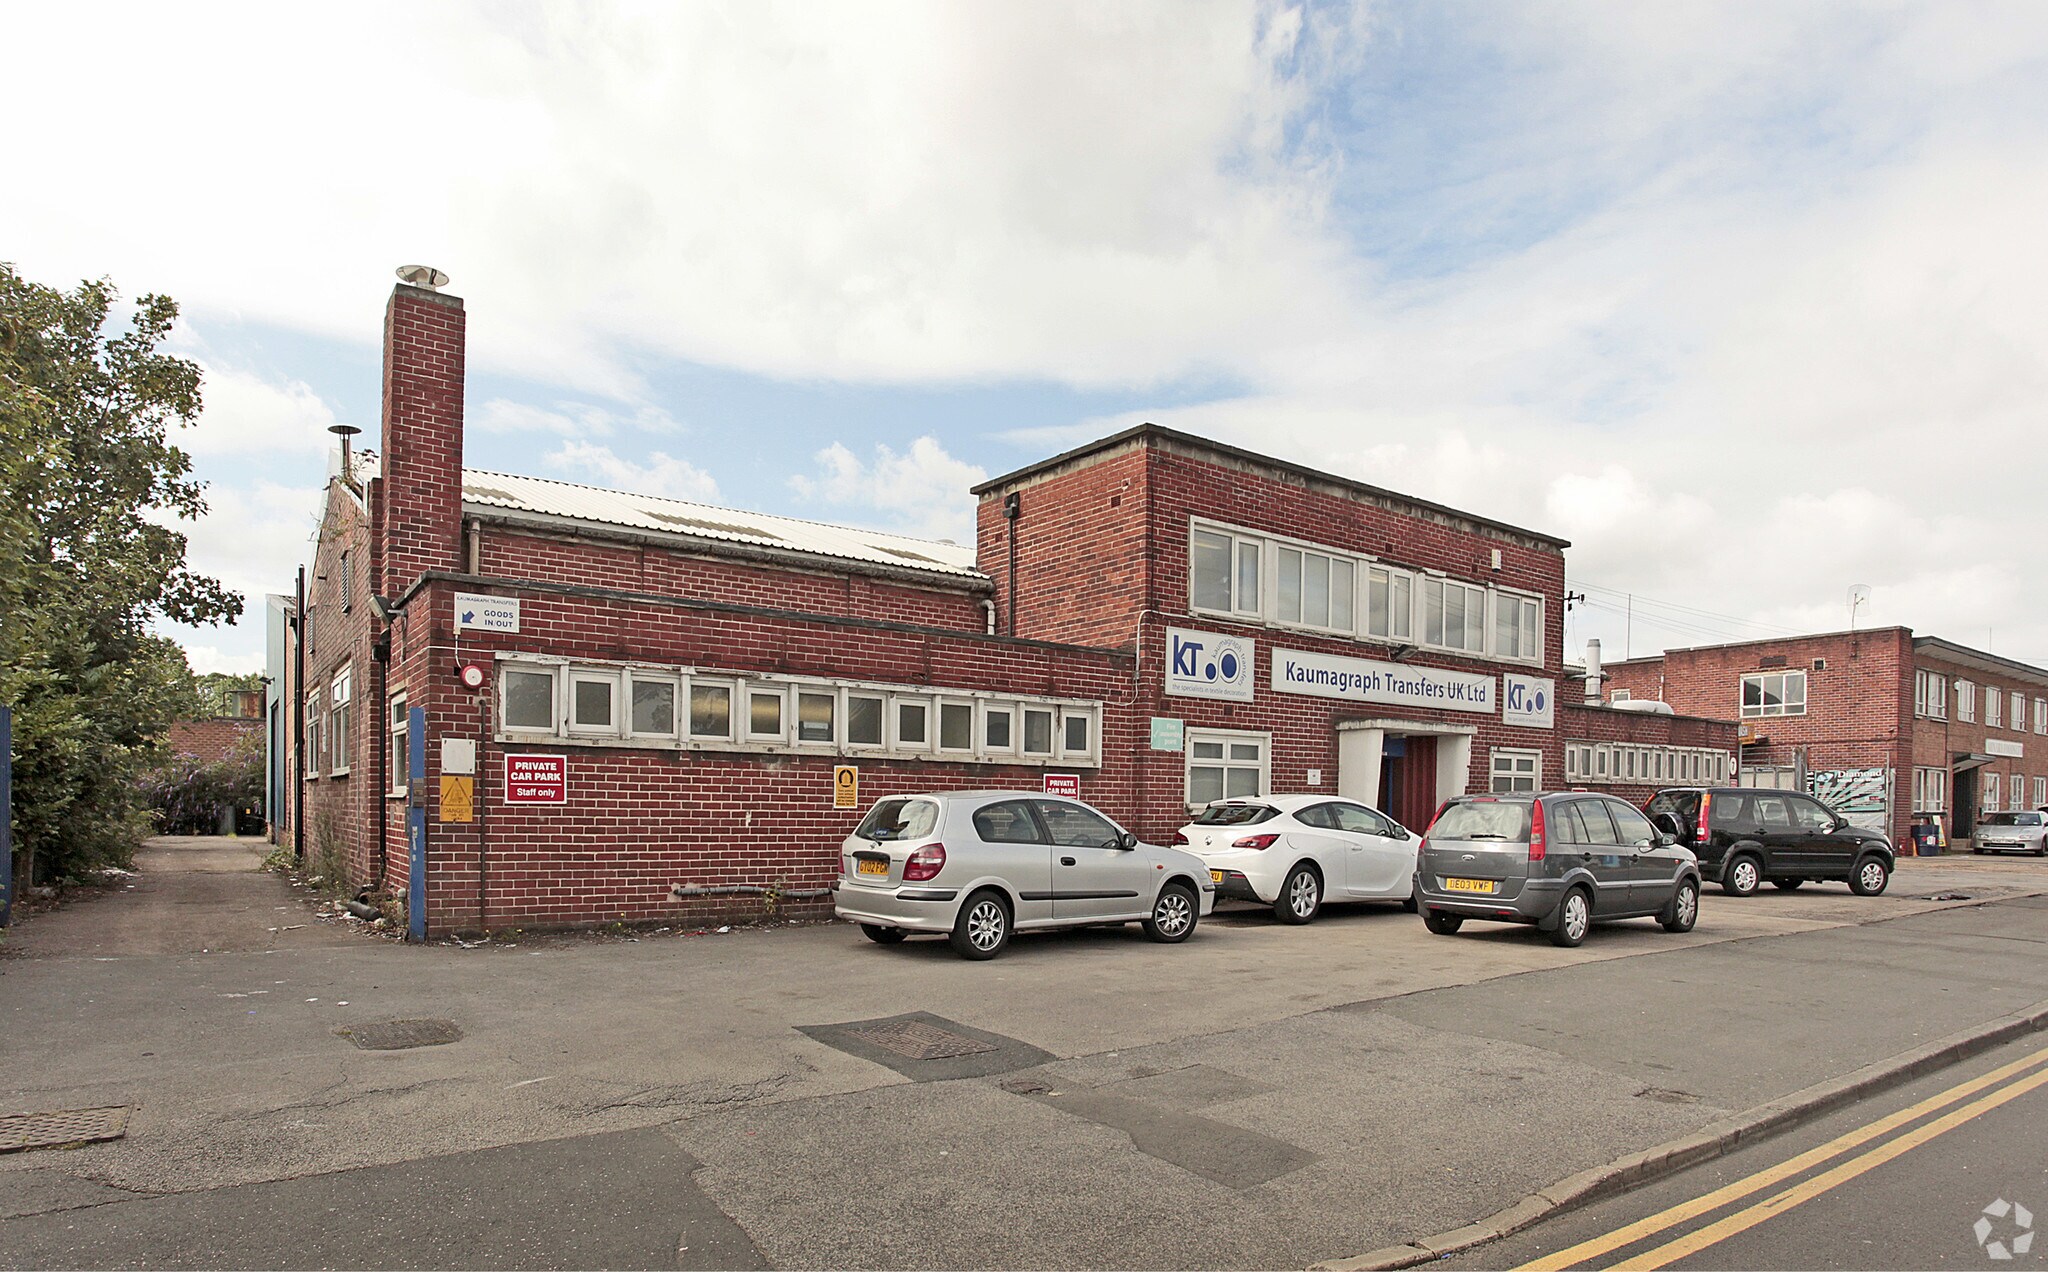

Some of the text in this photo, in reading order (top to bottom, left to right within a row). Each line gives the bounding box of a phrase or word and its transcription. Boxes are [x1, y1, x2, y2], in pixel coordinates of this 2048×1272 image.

[484, 609, 514, 619] GOODS
[484, 619, 513, 628] IN/OUT
[1173, 634, 1204, 677] KT
[1211, 638, 1247, 686] kaumagraph transfers
[1286, 660, 1486, 703] Kaumagraph Transfers UK Ltd
[1181, 685, 1204, 693] specialists
[1224, 689, 1247, 697] decoration
[1508, 679, 1526, 710] KT
[515, 761, 557, 771] PRIVATE
[510, 771, 562, 782] CAR PARK
[1837, 769, 1883, 778] Diamond
[1049, 779, 1074, 787] PRIVATE
[516, 787, 556, 799] Staff only
[1047, 787, 1077, 795] CAR PARK
